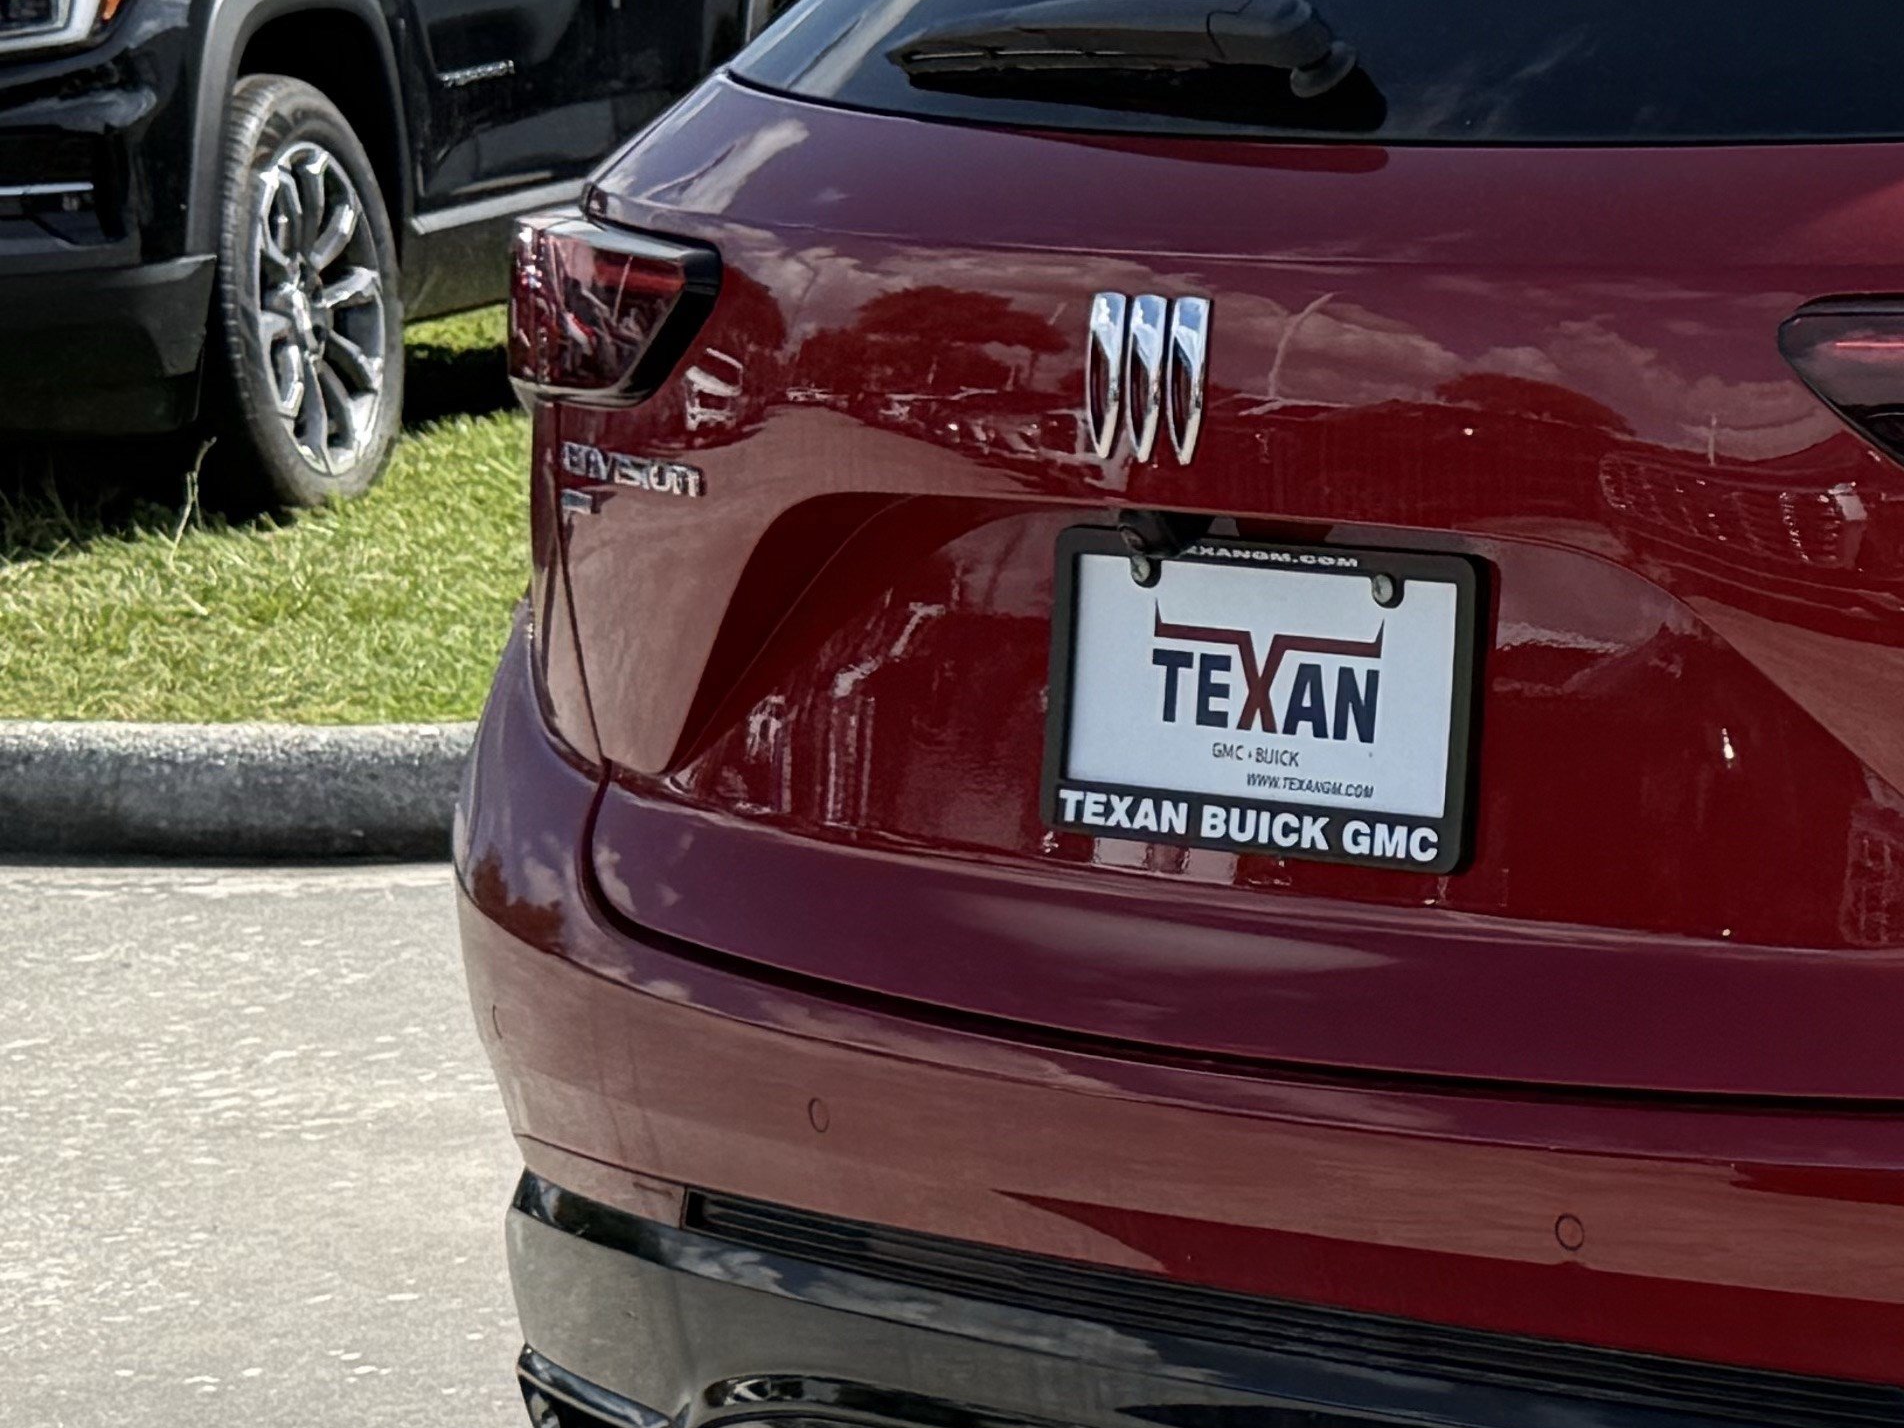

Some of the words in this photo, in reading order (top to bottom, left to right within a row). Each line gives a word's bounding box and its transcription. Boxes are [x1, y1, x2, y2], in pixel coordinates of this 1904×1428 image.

[1152, 632, 1381, 745] TEXAN
[1211, 741, 1245, 762] GMC
[1255, 746, 1300, 768] BUICK
[1058, 788, 1189, 835] TEXAN
[1201, 805, 1330, 851] BUICK
[1342, 820, 1439, 862] GMC
